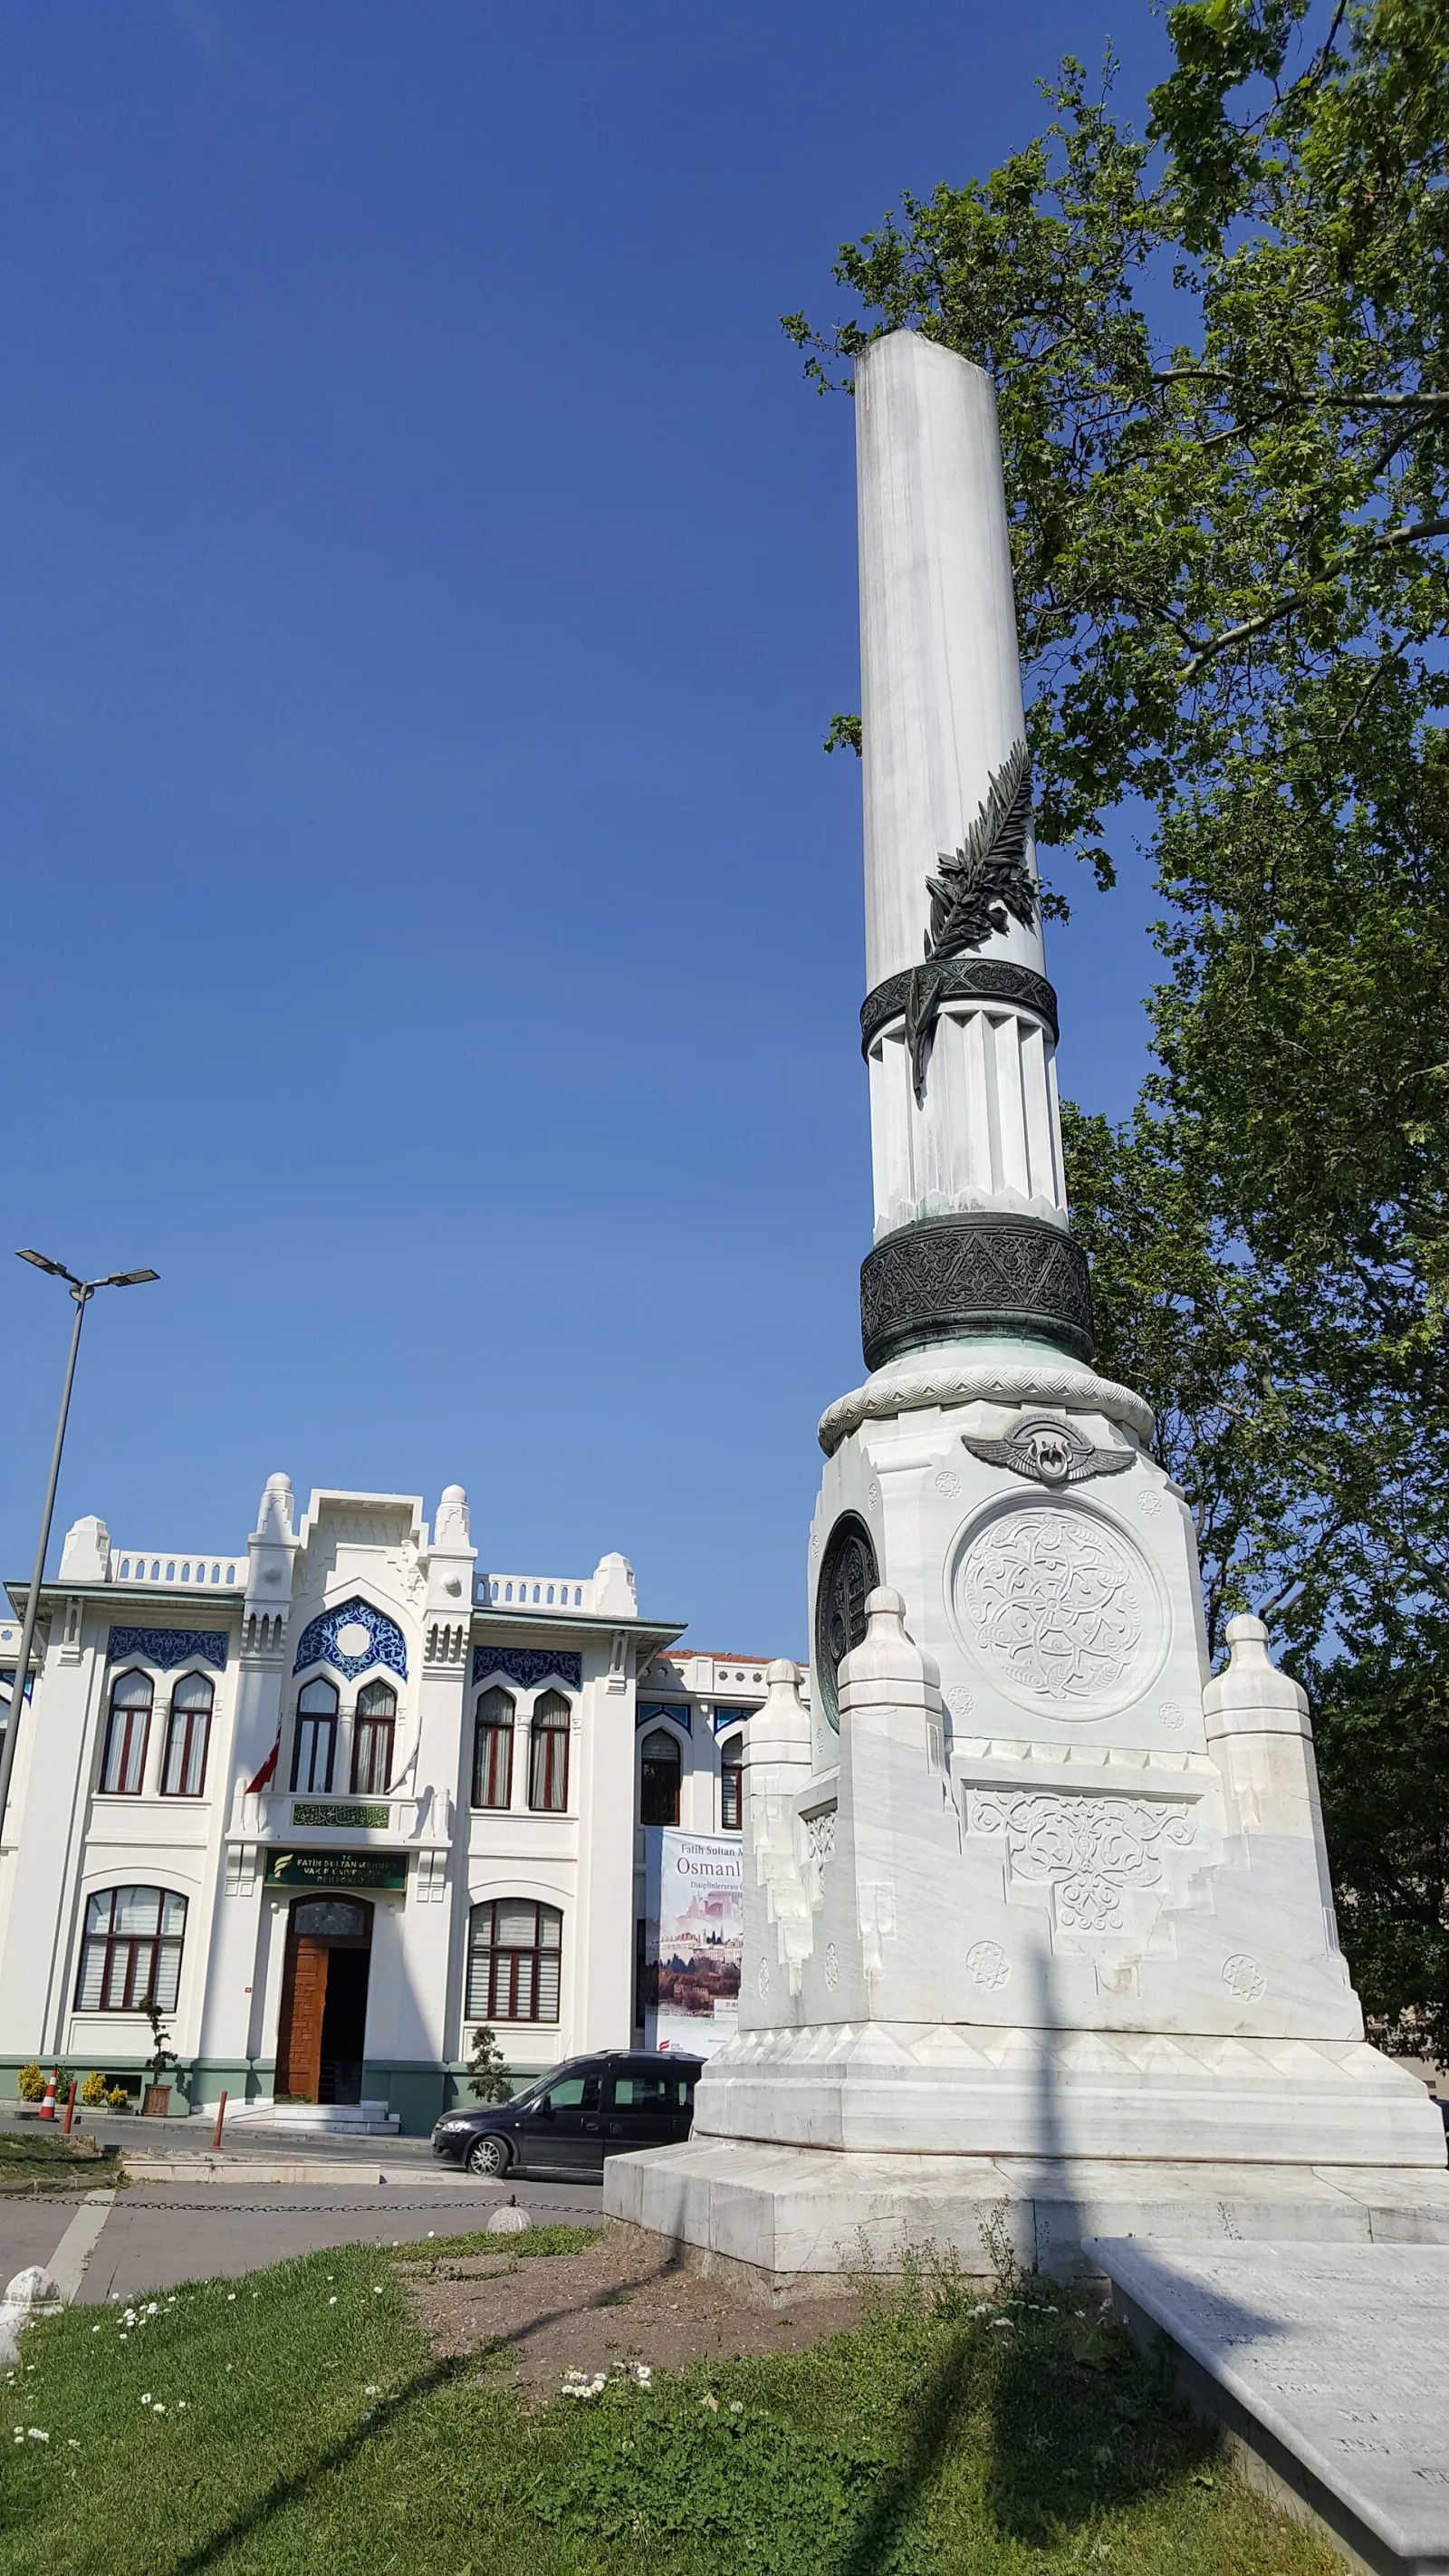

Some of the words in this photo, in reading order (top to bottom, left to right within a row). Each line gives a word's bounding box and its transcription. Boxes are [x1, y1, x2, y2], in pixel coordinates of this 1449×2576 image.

[681, 1844, 704, 1855] Fatih
[706, 1846, 735, 1856] Sultan
[297, 1859, 322, 1867] FATİH
[324, 1860, 357, 1870] SULTAN
[359, 1862, 396, 1870] MEHMET
[677, 1858, 743, 1877] Osmanl
